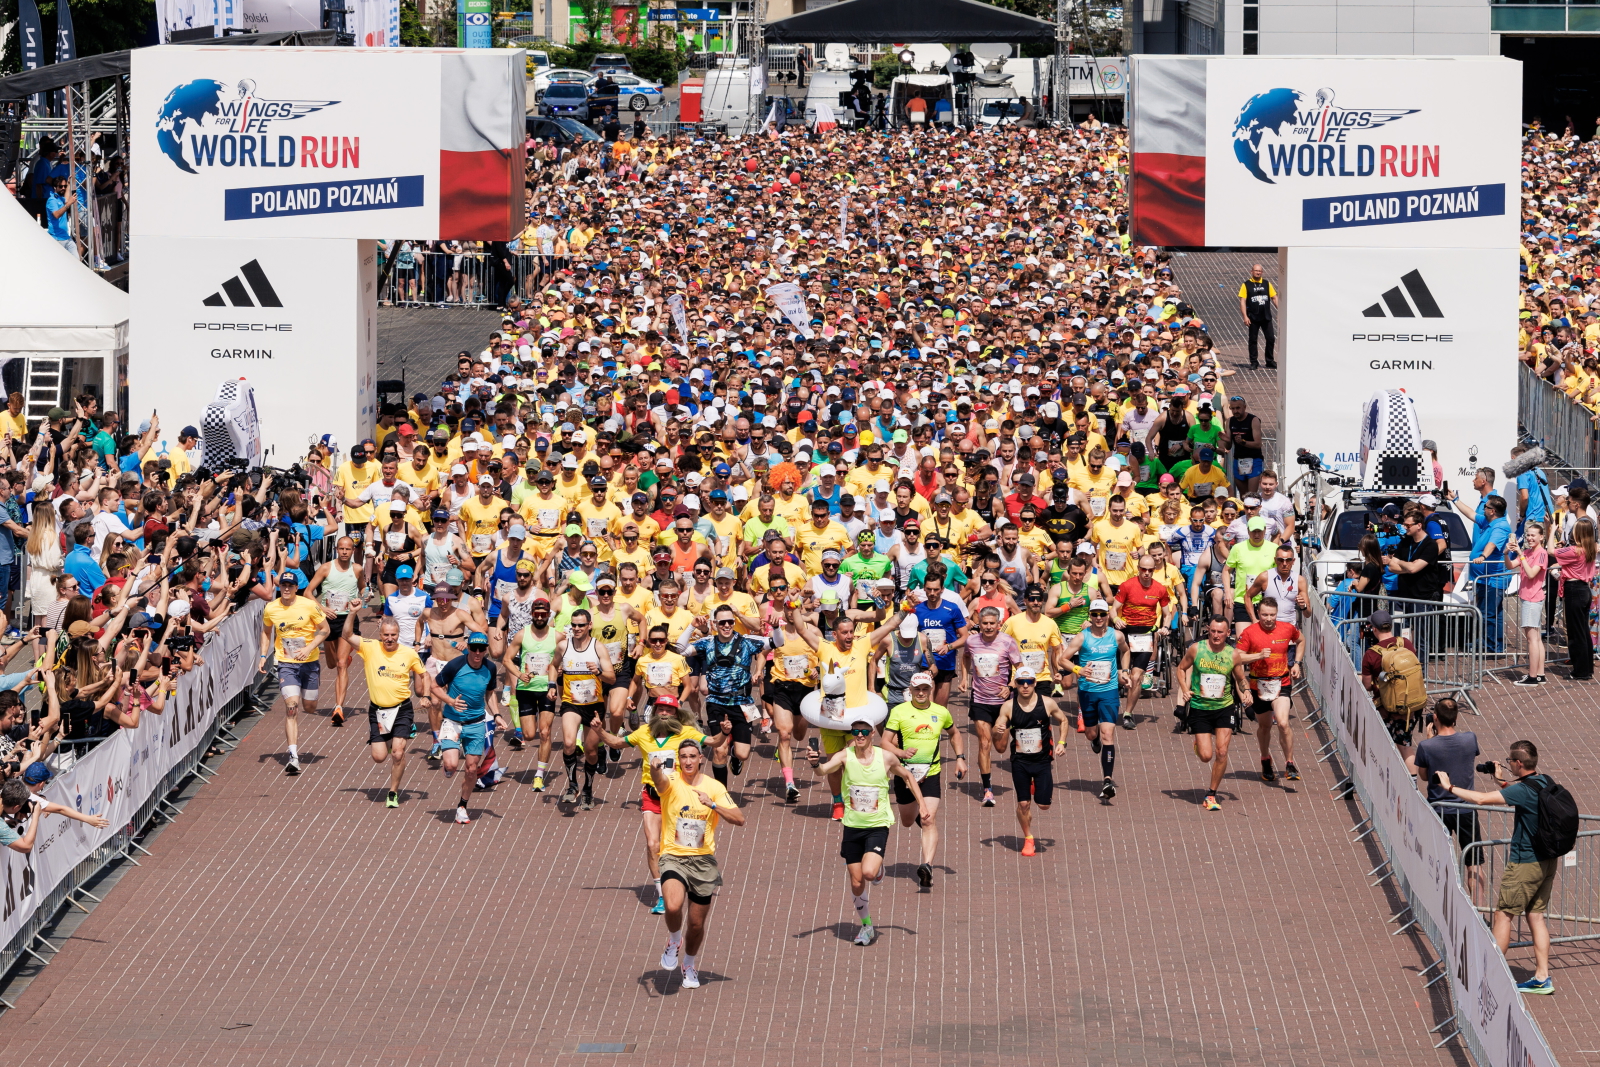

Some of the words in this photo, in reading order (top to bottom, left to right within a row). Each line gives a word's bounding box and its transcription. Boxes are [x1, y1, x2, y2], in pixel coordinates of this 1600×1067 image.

[243, 12, 269, 23] Polski
[708, 9, 716, 20] 7
[228, 118, 272, 133] LIFE
[1293, 127, 1309, 135] FOR
[1306, 127, 1350, 142] LIFE
[251, 188, 321, 214] POLAND
[327, 177, 398, 208] POZNAŃ
[1329, 197, 1400, 223] POLAND
[1406, 186, 1479, 217] POZNAŃ
[193, 323, 293, 332] PORSCHE
[1352, 334, 1454, 342] PORSCHE
[210, 348, 272, 359] GARMIN
[1369, 359, 1432, 370] GARMIN
[1457, 466, 1477, 477] Mac
